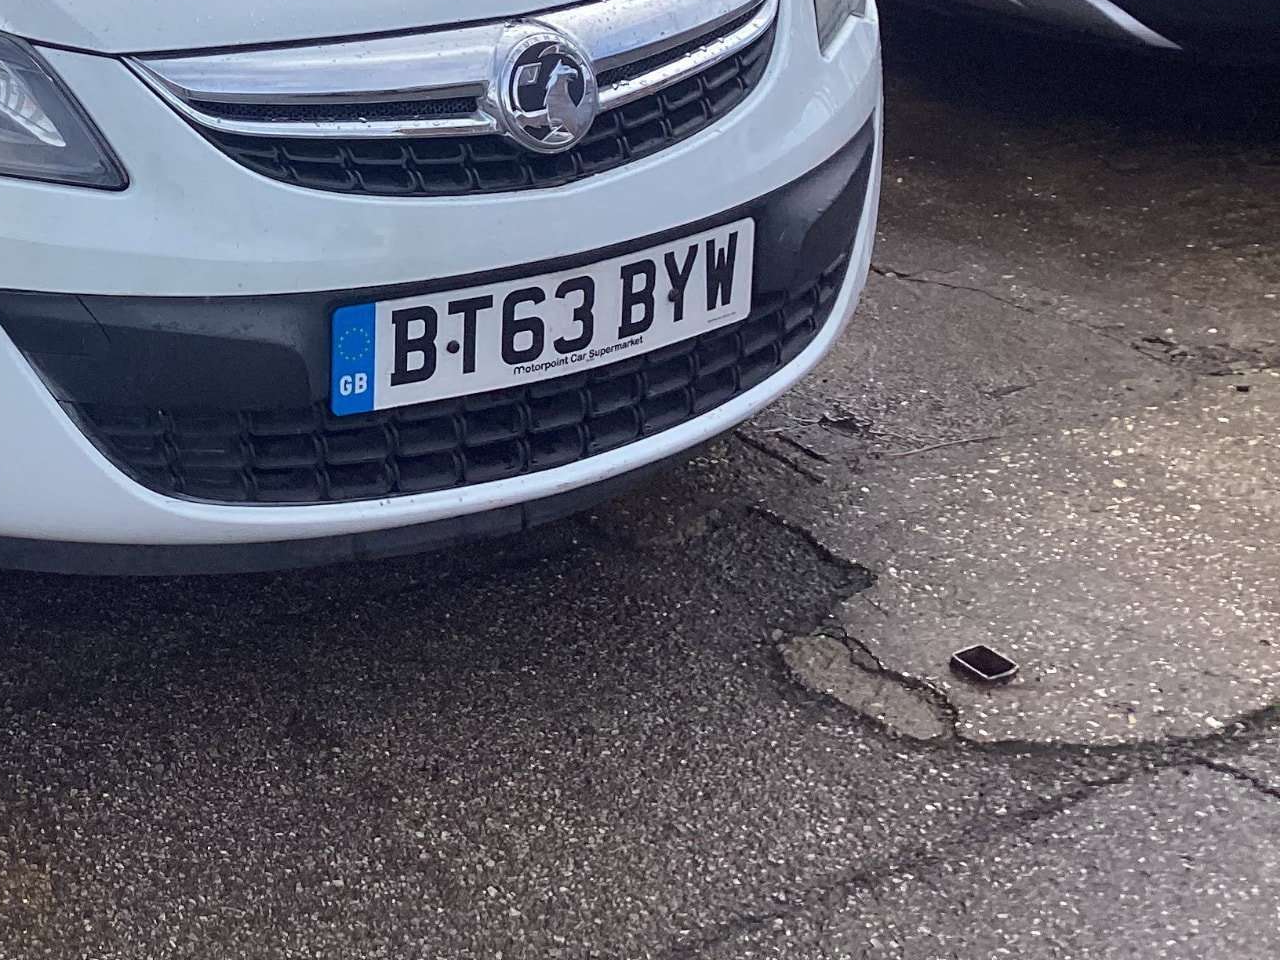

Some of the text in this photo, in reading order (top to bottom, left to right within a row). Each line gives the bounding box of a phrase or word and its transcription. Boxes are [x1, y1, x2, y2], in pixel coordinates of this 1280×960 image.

[390, 231, 738, 387] BT63 BYW
[513, 335, 643, 375] Motorpoint Car Supermarket
[339, 372, 368, 397] GB
